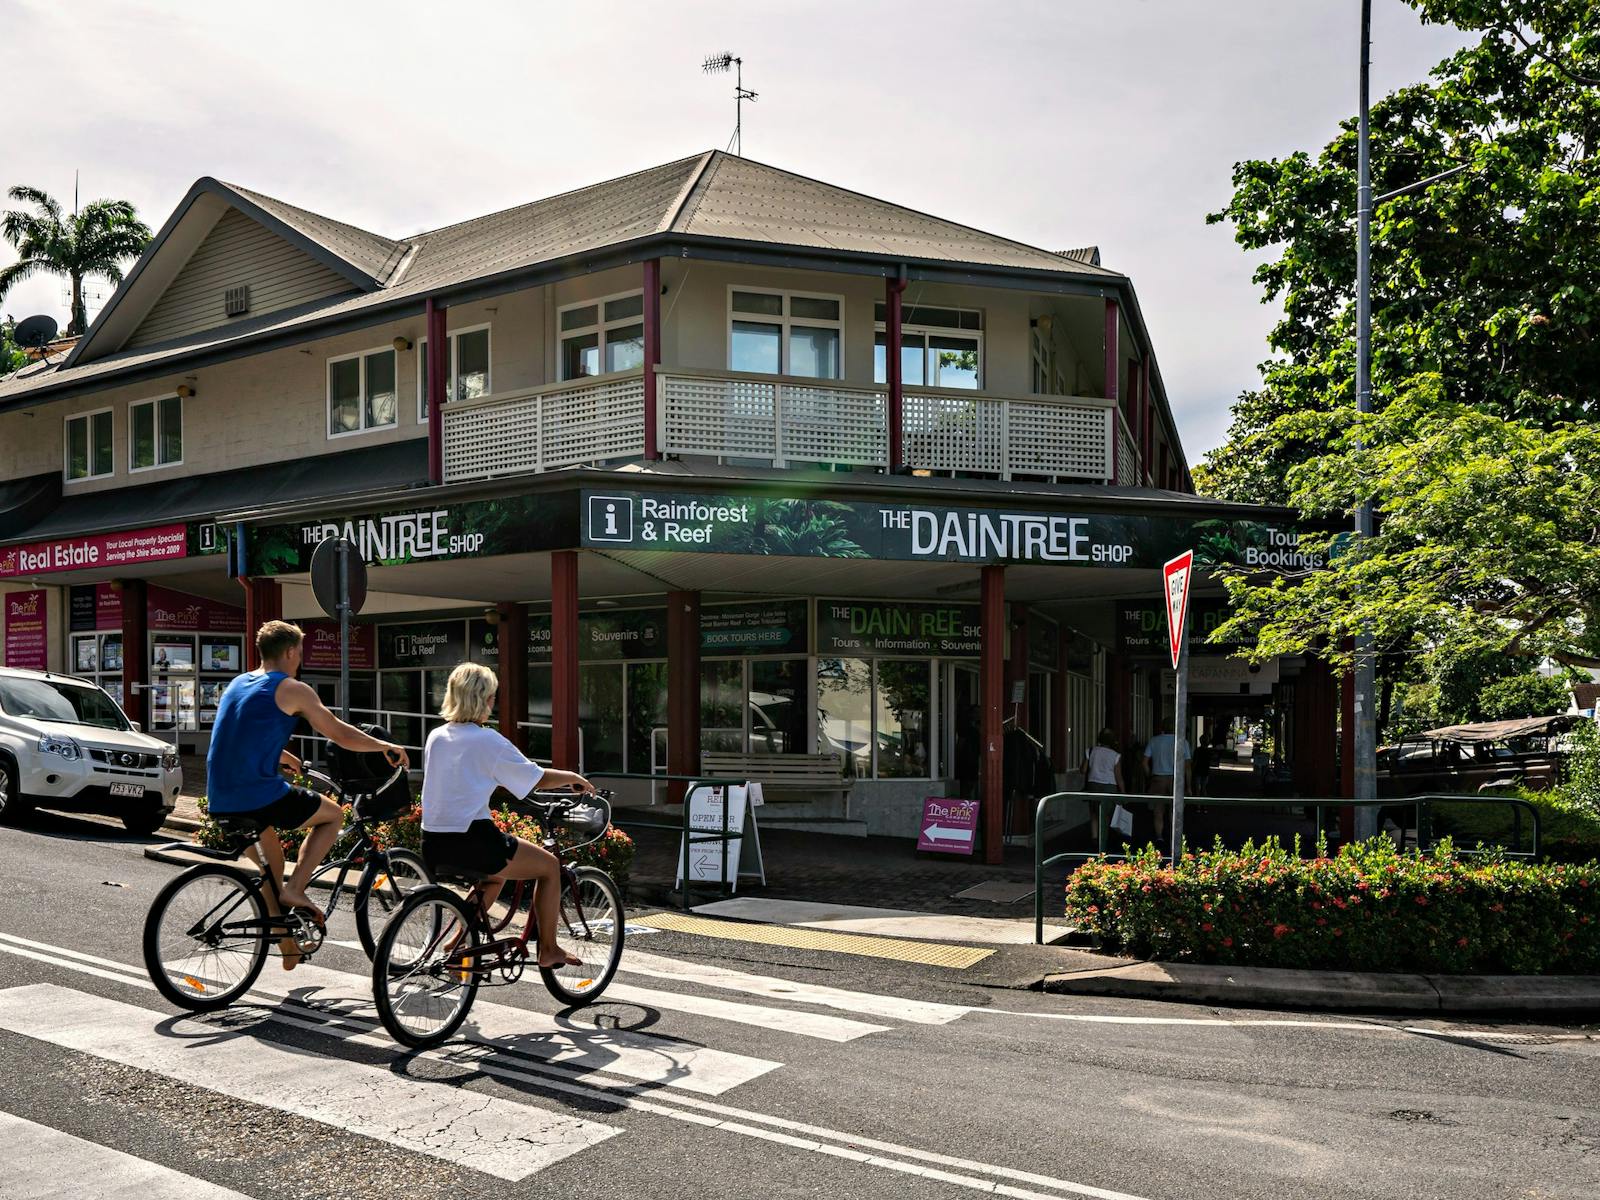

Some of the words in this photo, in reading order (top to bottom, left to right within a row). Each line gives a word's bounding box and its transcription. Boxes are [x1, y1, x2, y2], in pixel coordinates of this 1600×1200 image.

[641, 498, 749, 523] Rainforest
[641, 522, 658, 541] &
[663, 522, 713, 544] Reef
[879, 509, 911, 529] THE
[1091, 543, 1133, 563] SHOP
[118, 538, 134, 548] Local
[302, 526, 322, 545] THE
[450, 533, 484, 554] SHOP
[20, 547, 51, 571] Real
[55, 541, 99, 567] Estate
[106, 550, 126, 561] Serving
[126, 549, 136, 558] the
[166, 544, 180, 554] 2009
[1246, 547, 1324, 570] Bookings
[831, 606, 850, 619] THE
[1125, 610, 1142, 621] THE
[411, 633, 448, 645] Rainforest
[530, 629, 551, 642] 5430
[591, 628, 639, 642] Souvenirs
[706, 634, 729, 643] BOOK
[730, 632, 757, 642] TOURS
[758, 631, 782, 641] HERE
[1125, 636, 1150, 646] Tours
[411, 645, 418, 656] &
[418, 644, 436, 656] Reef
[831, 637, 861, 648] Tours
[875, 638, 931, 650] Information
[928, 803, 949, 816] The
[950, 806, 972, 817] Pink
[692, 814, 716, 823] OPEN
[718, 815, 736, 824] FR
